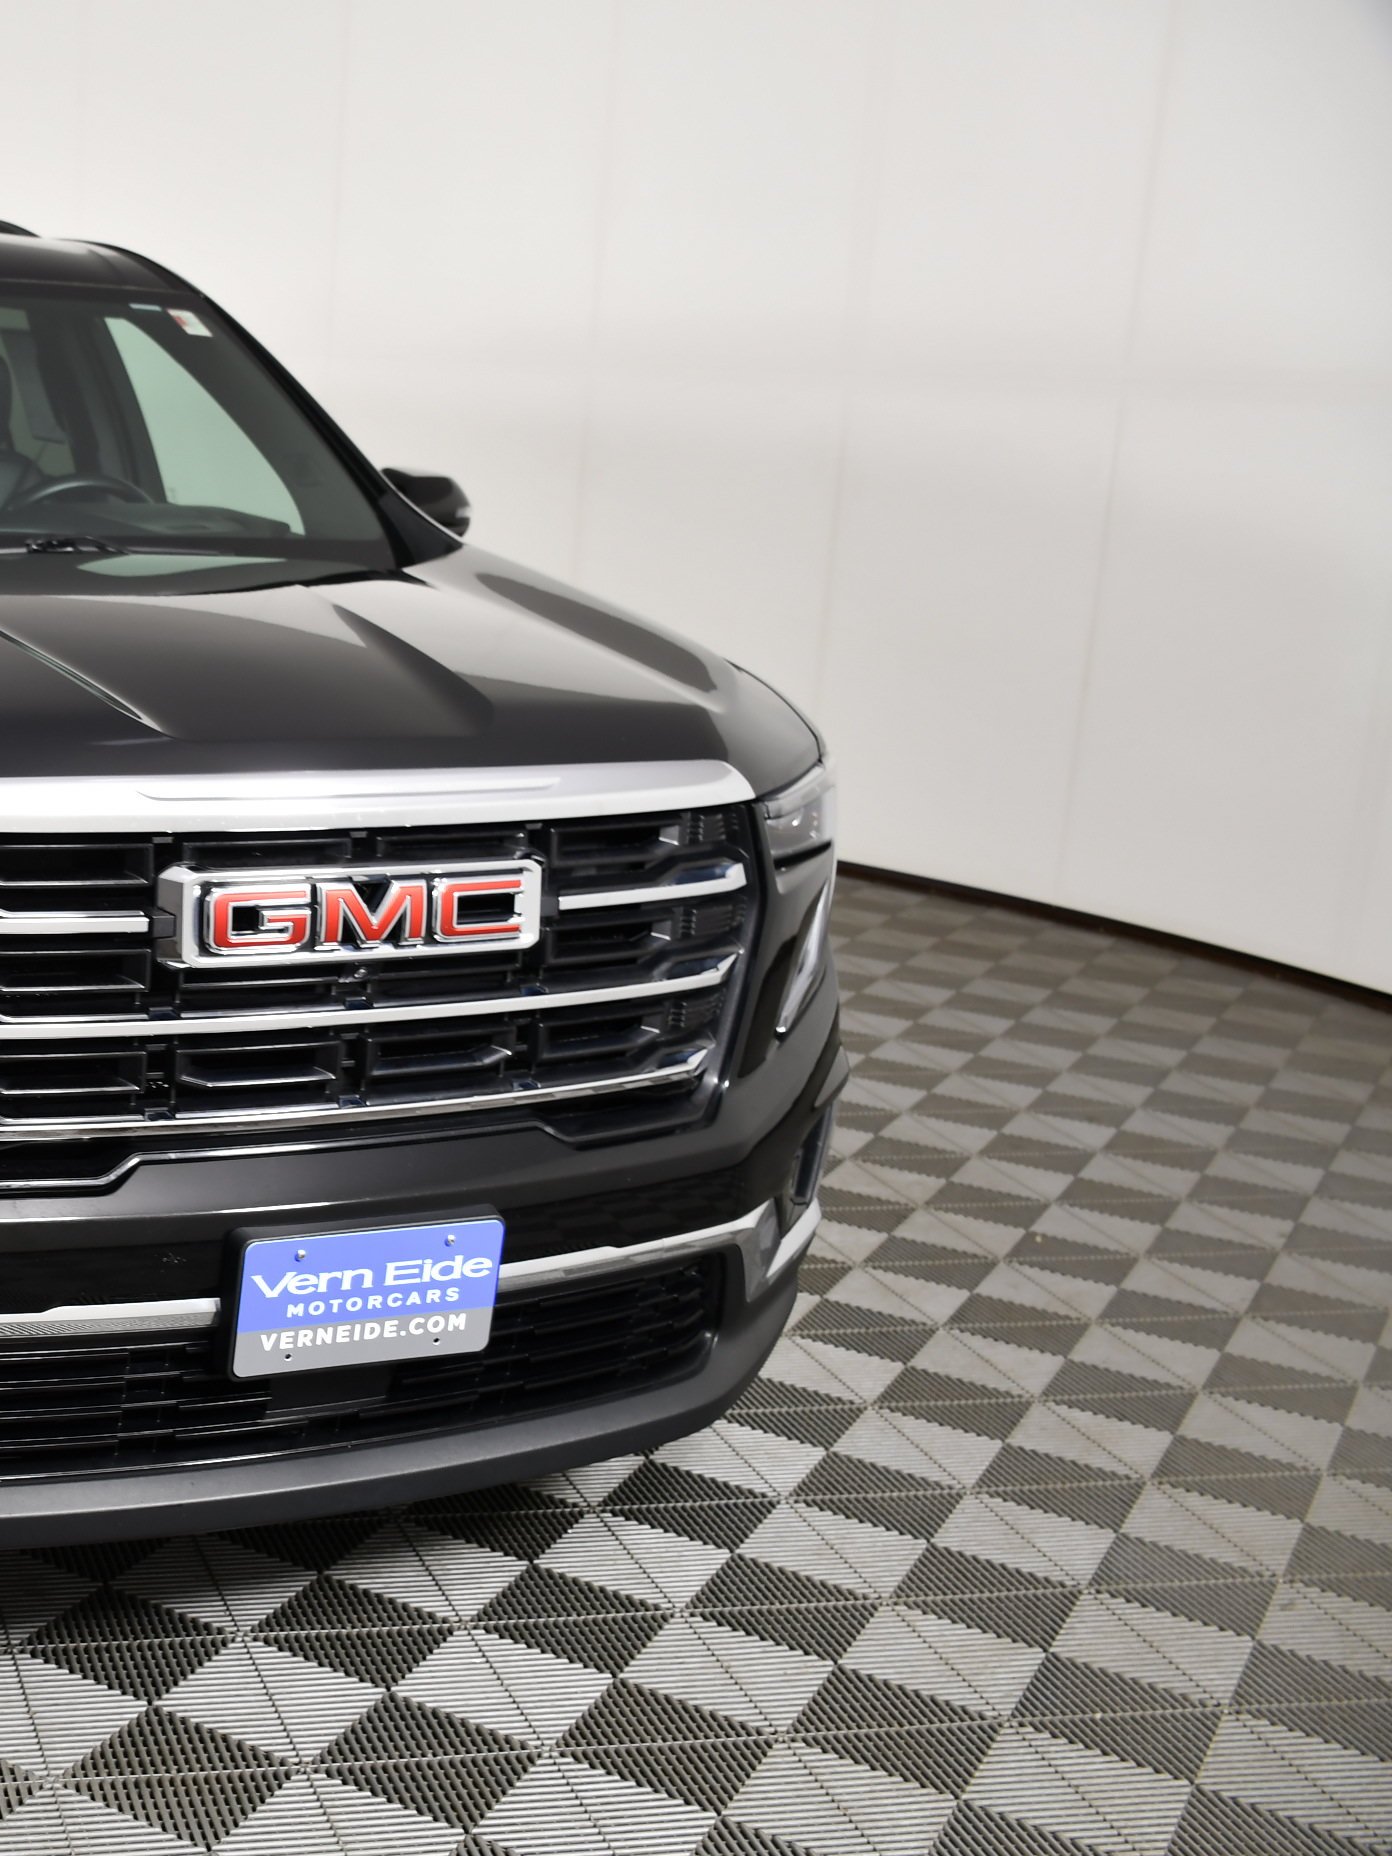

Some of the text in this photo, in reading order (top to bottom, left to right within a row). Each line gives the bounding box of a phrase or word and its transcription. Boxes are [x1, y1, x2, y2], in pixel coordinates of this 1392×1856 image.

[207, 876, 522, 955] GMC
[251, 1255, 493, 1299] Vern Eide
[286, 1287, 460, 1318] MOTORCARS
[260, 1313, 466, 1351] VERNEIDE.COM
